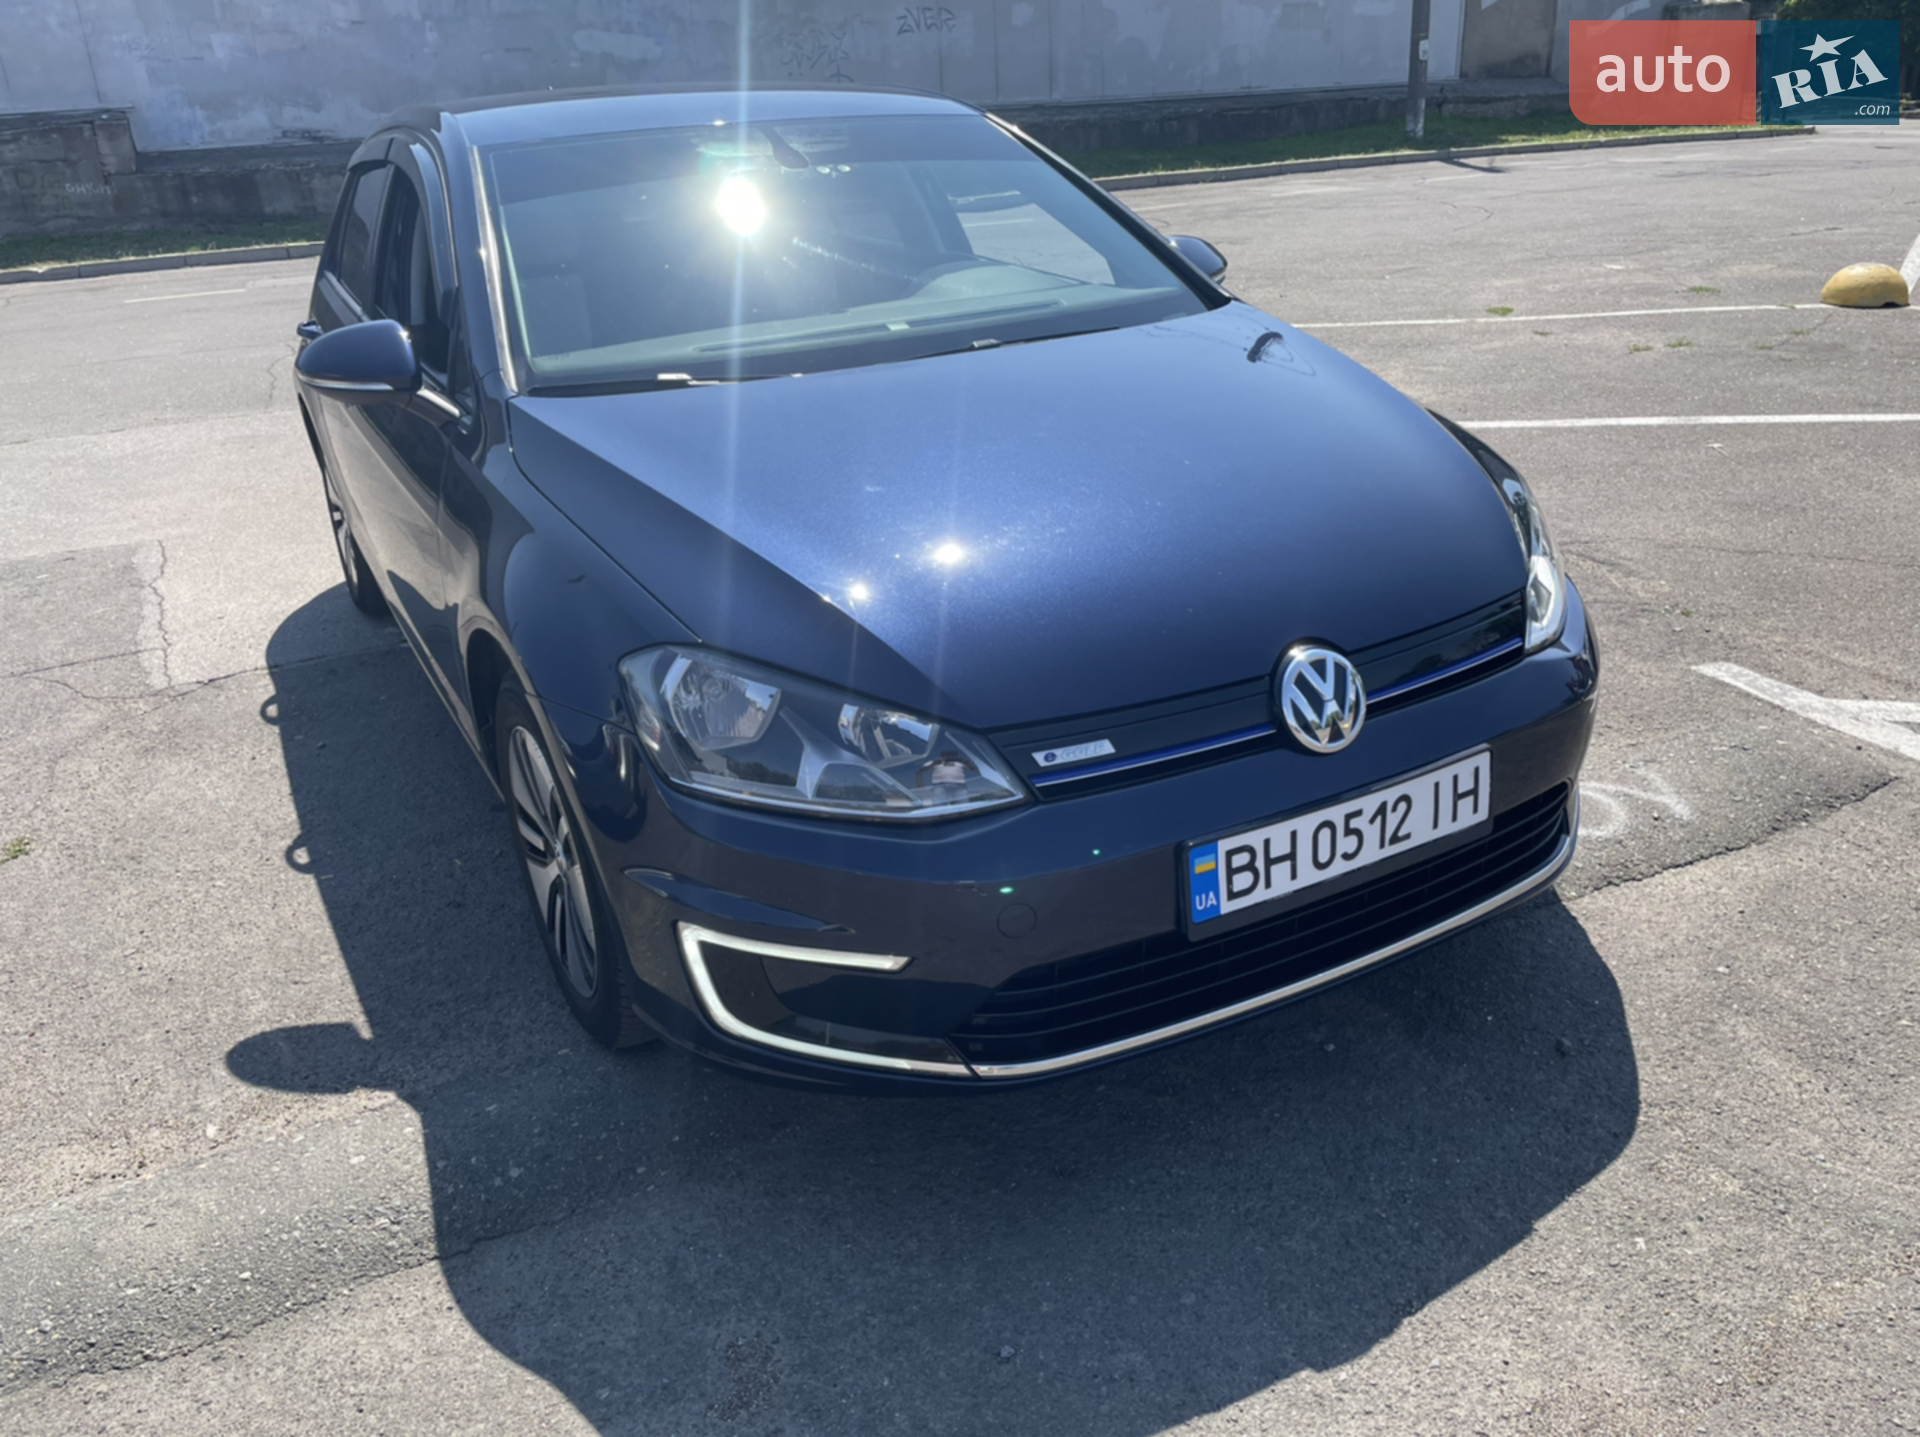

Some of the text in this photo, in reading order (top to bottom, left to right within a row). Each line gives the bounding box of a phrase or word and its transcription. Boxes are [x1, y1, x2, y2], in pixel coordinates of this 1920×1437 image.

[1225, 765, 1480, 902] BH 0512 IH
[1195, 891, 1217, 911] UA
